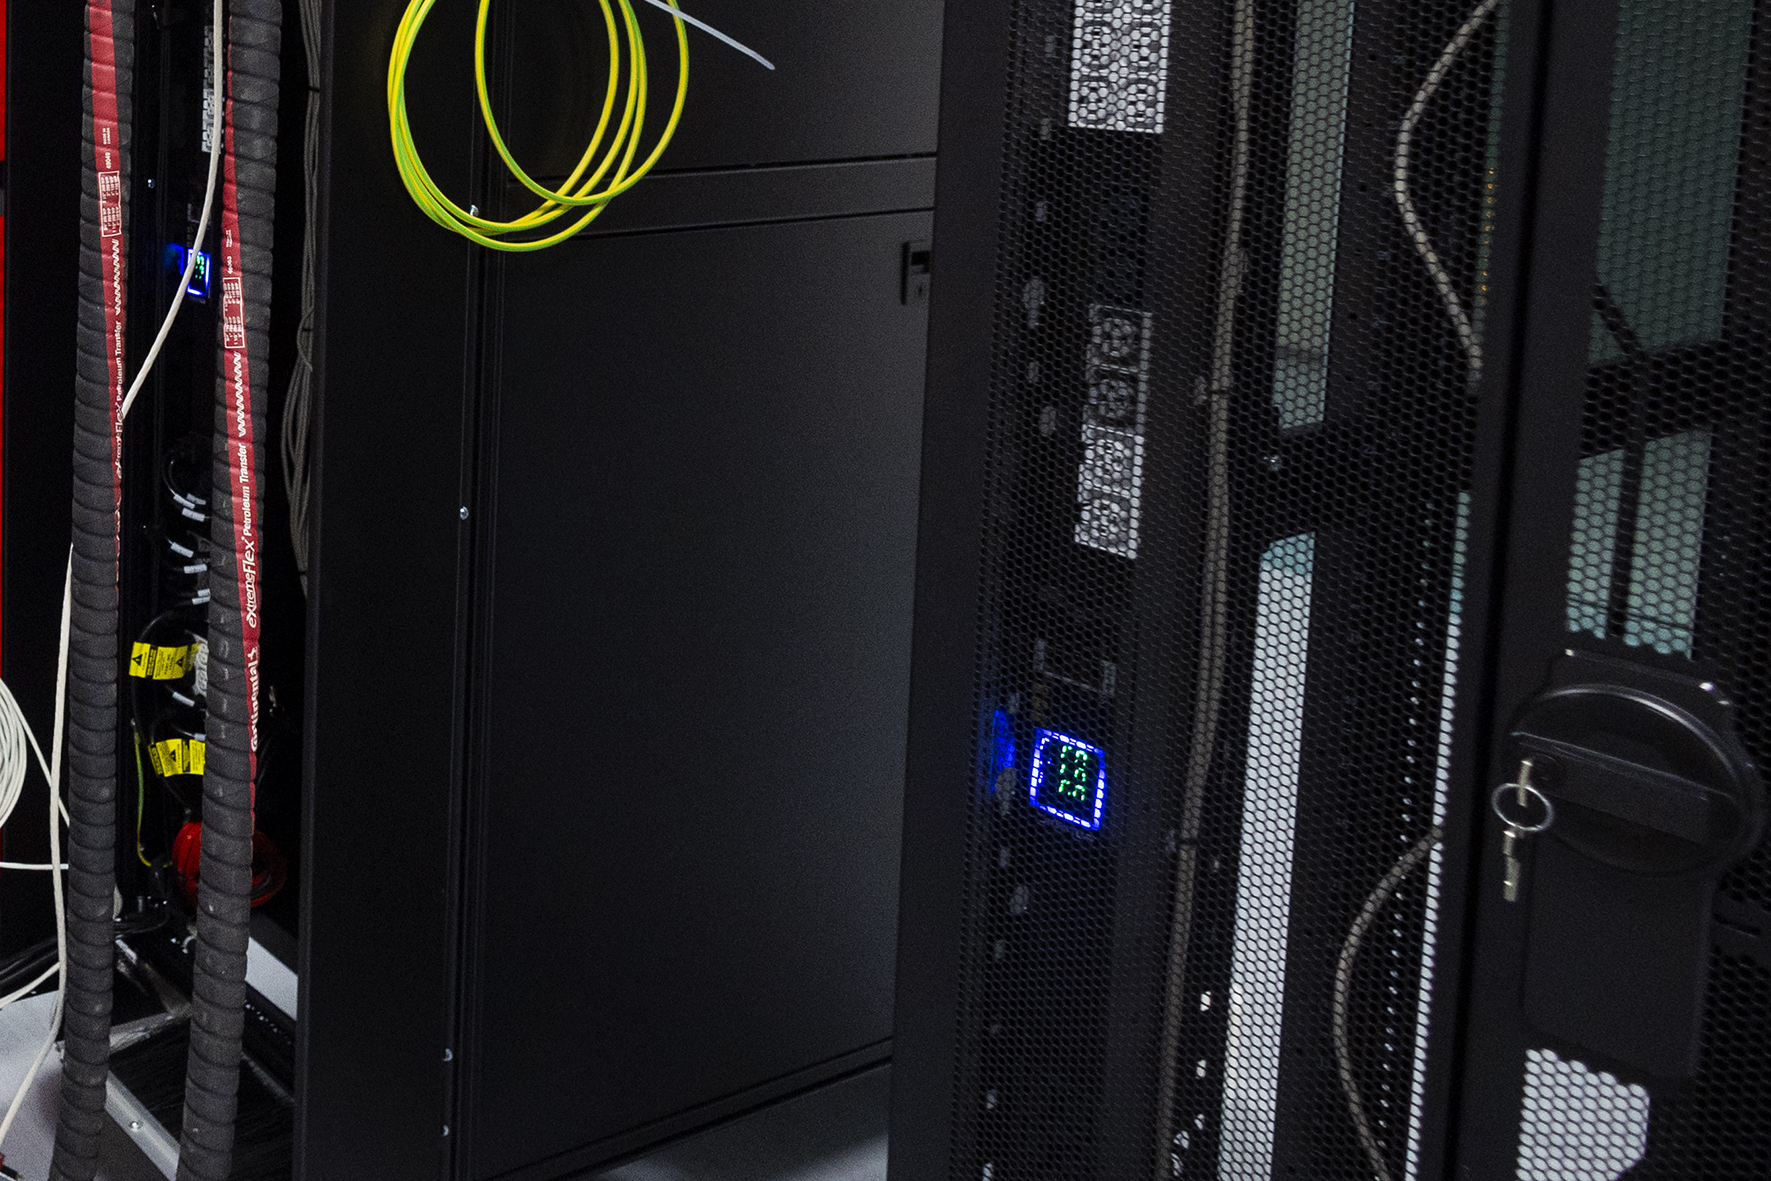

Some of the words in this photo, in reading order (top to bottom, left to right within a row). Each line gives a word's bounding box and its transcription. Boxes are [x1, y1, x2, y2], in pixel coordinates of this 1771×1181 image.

[115, 357, 123, 401] Petroleum
[239, 443, 249, 483] Transfer
[242, 486, 252, 537] Petroleum
